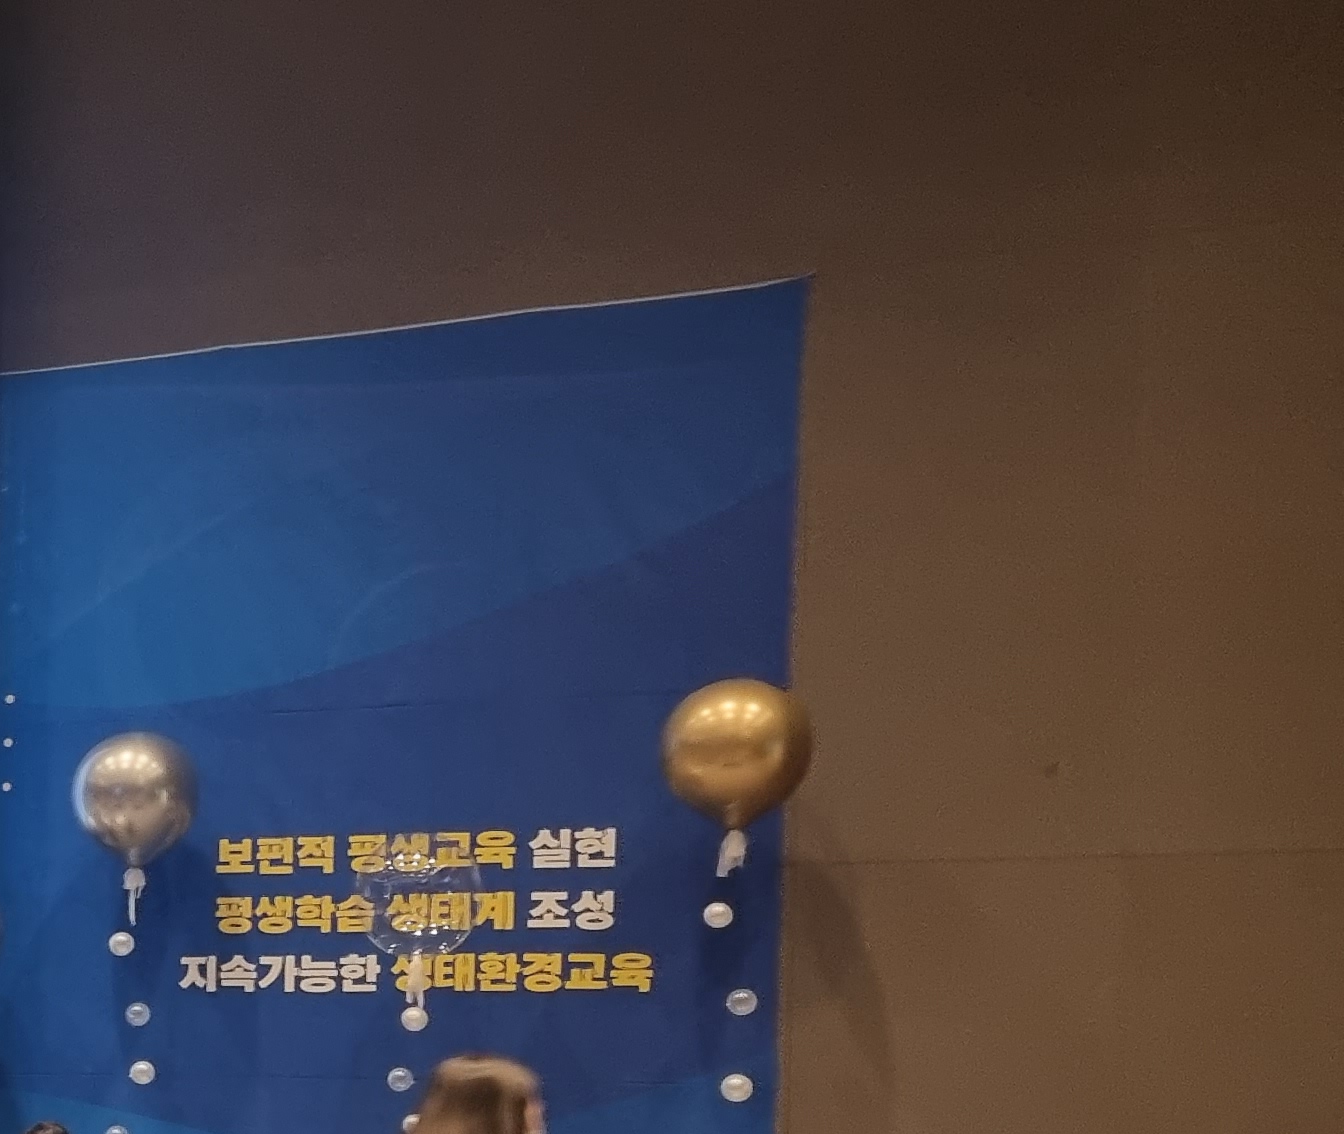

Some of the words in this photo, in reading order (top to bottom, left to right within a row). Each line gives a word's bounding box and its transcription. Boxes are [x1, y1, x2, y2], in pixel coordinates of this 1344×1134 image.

[215, 835, 335, 874] 보편적
[347, 830, 517, 873] 평생교육
[528, 827, 617, 869] 실현
[215, 894, 376, 934] 평생학습
[386, 890, 516, 932] 생태계
[526, 890, 616, 931] 조성
[178, 953, 382, 993] 지속가능한
[390, 953, 655, 993] 생태환경교육
